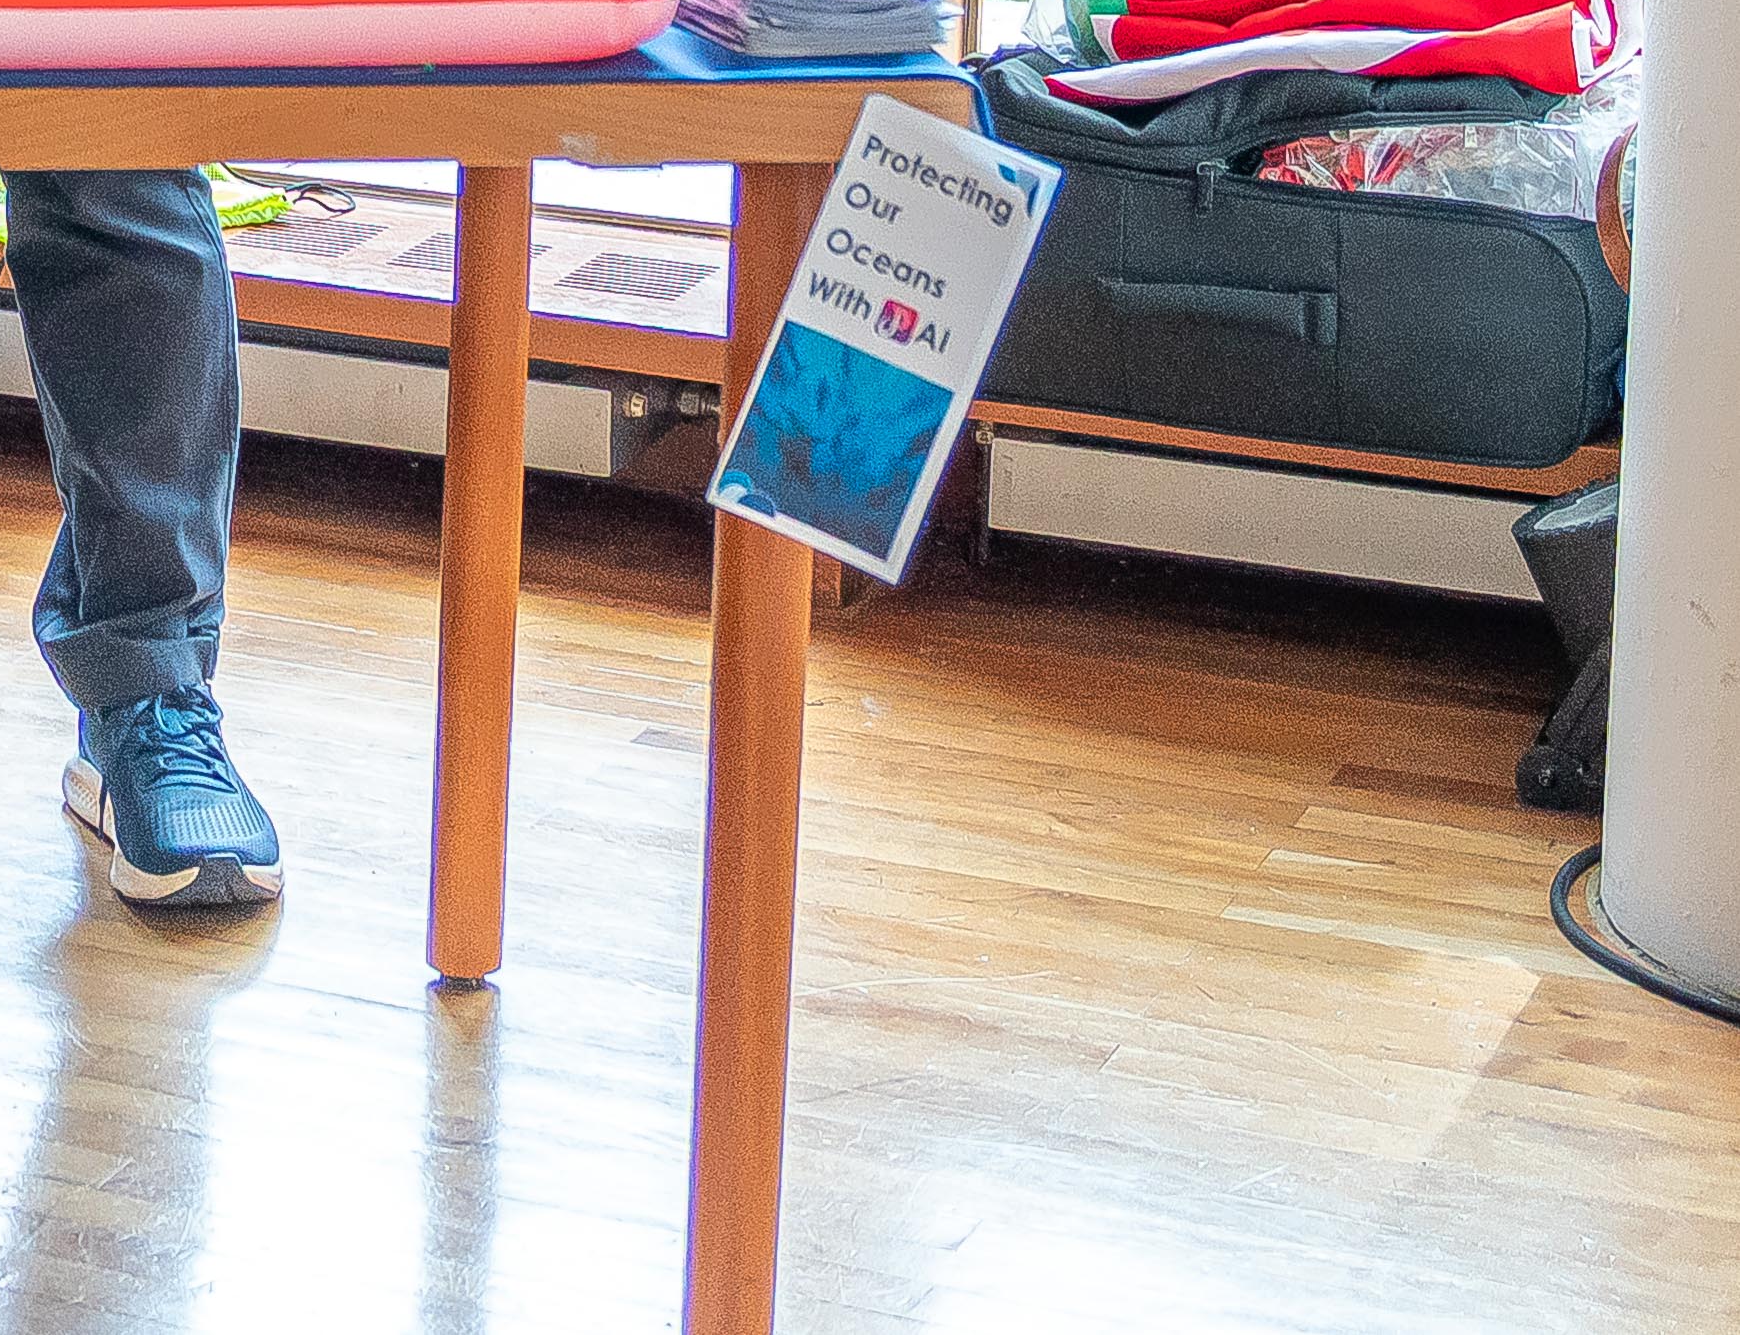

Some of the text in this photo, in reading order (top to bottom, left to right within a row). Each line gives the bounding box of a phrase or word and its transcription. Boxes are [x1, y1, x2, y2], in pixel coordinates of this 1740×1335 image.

[845, 182, 903, 224] Our
[862, 134, 1015, 228] Protecting
[826, 228, 947, 299] Oceans
[808, 271, 950, 354] With AI
